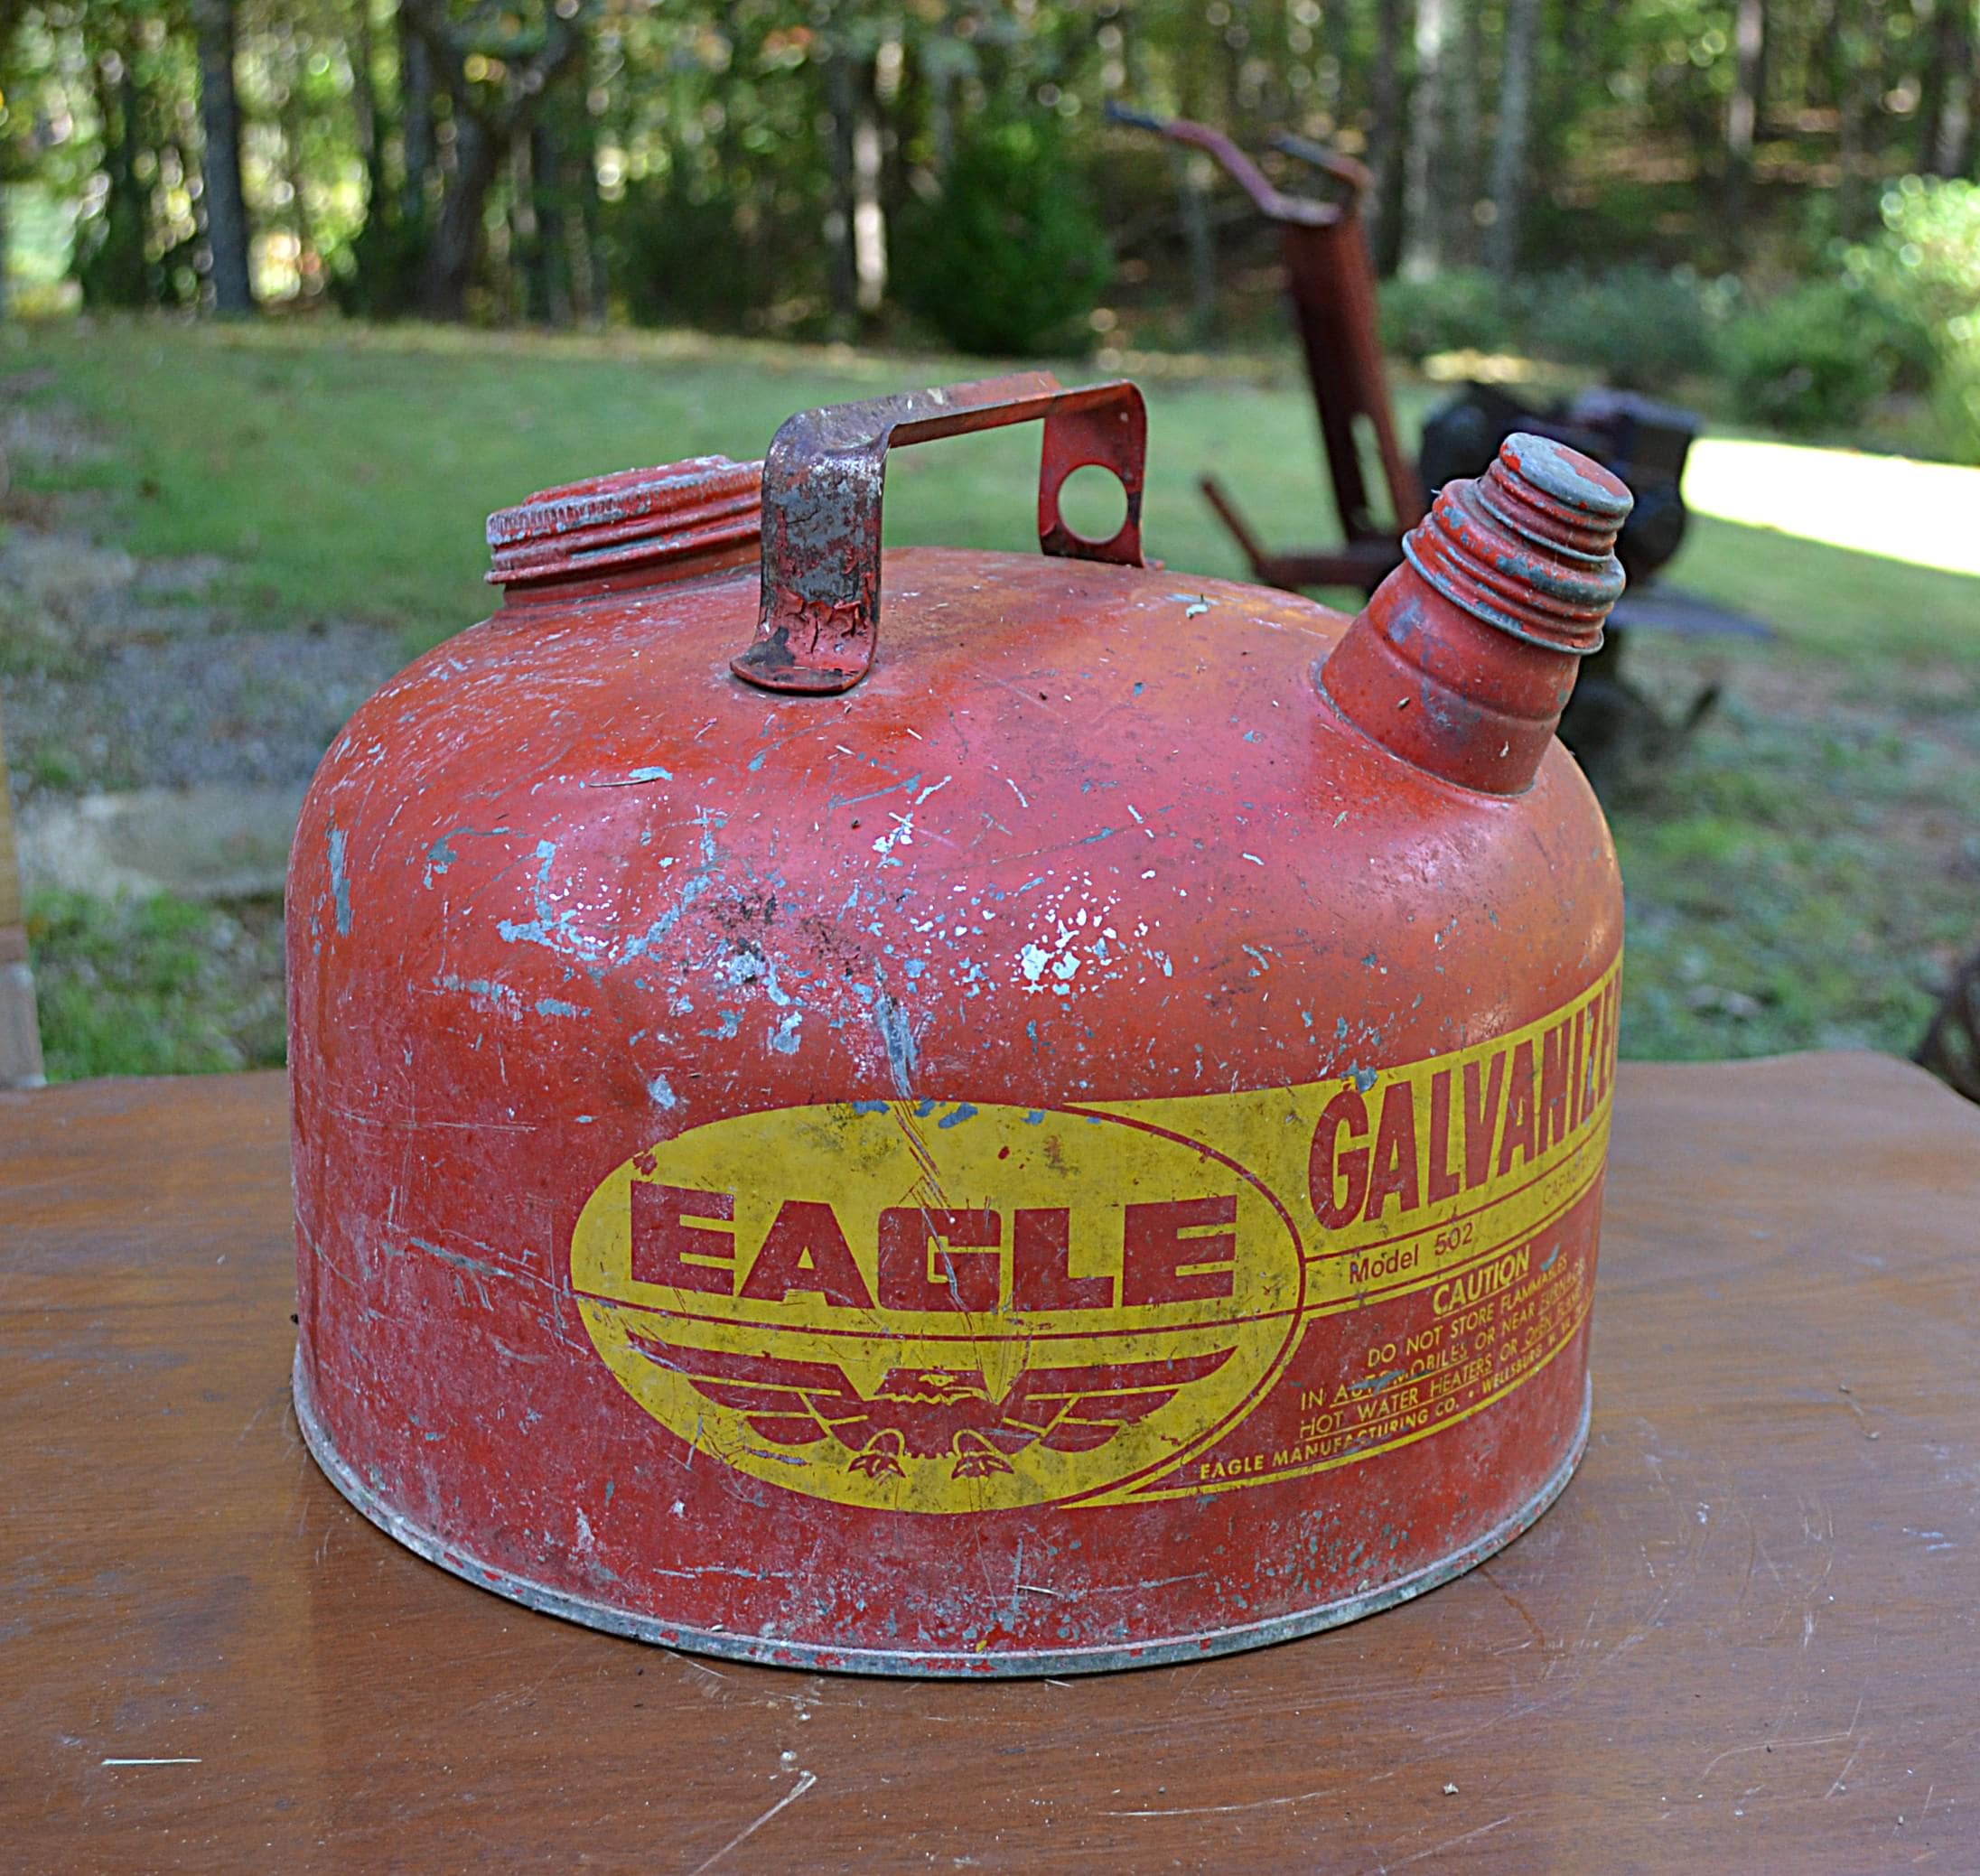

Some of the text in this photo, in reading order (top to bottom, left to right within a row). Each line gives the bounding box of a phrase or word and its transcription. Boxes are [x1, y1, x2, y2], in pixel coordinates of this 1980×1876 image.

[1307, 964, 1620, 1230] GALVANIZE
[630, 1179, 1237, 1312] EAGLE
[1349, 1223, 1474, 1283] Model 502
[1433, 1244, 1530, 1315] CAUTION
[1301, 1387, 1325, 1411] IN
[1475, 1326, 1496, 1351] OR
[1501, 1302, 1536, 1338] NEAR
[1368, 1343, 1396, 1367] DO
[1406, 1325, 1443, 1356] NOT
[1451, 1302, 1494, 1339] STORE
[1200, 1455, 1264, 1480] EAGLE
[1272, 1408, 1428, 1466] MANUFACTURING
[1435, 1397, 1460, 1417] CO.
[1482, 1343, 1543, 1394] WELLSBURG
[1300, 1411, 1343, 1439] HOT
[1358, 1386, 1419, 1422] WATER
[1430, 1354, 1492, 1397] HEATERS
[1499, 1339, 1518, 1362] OR
